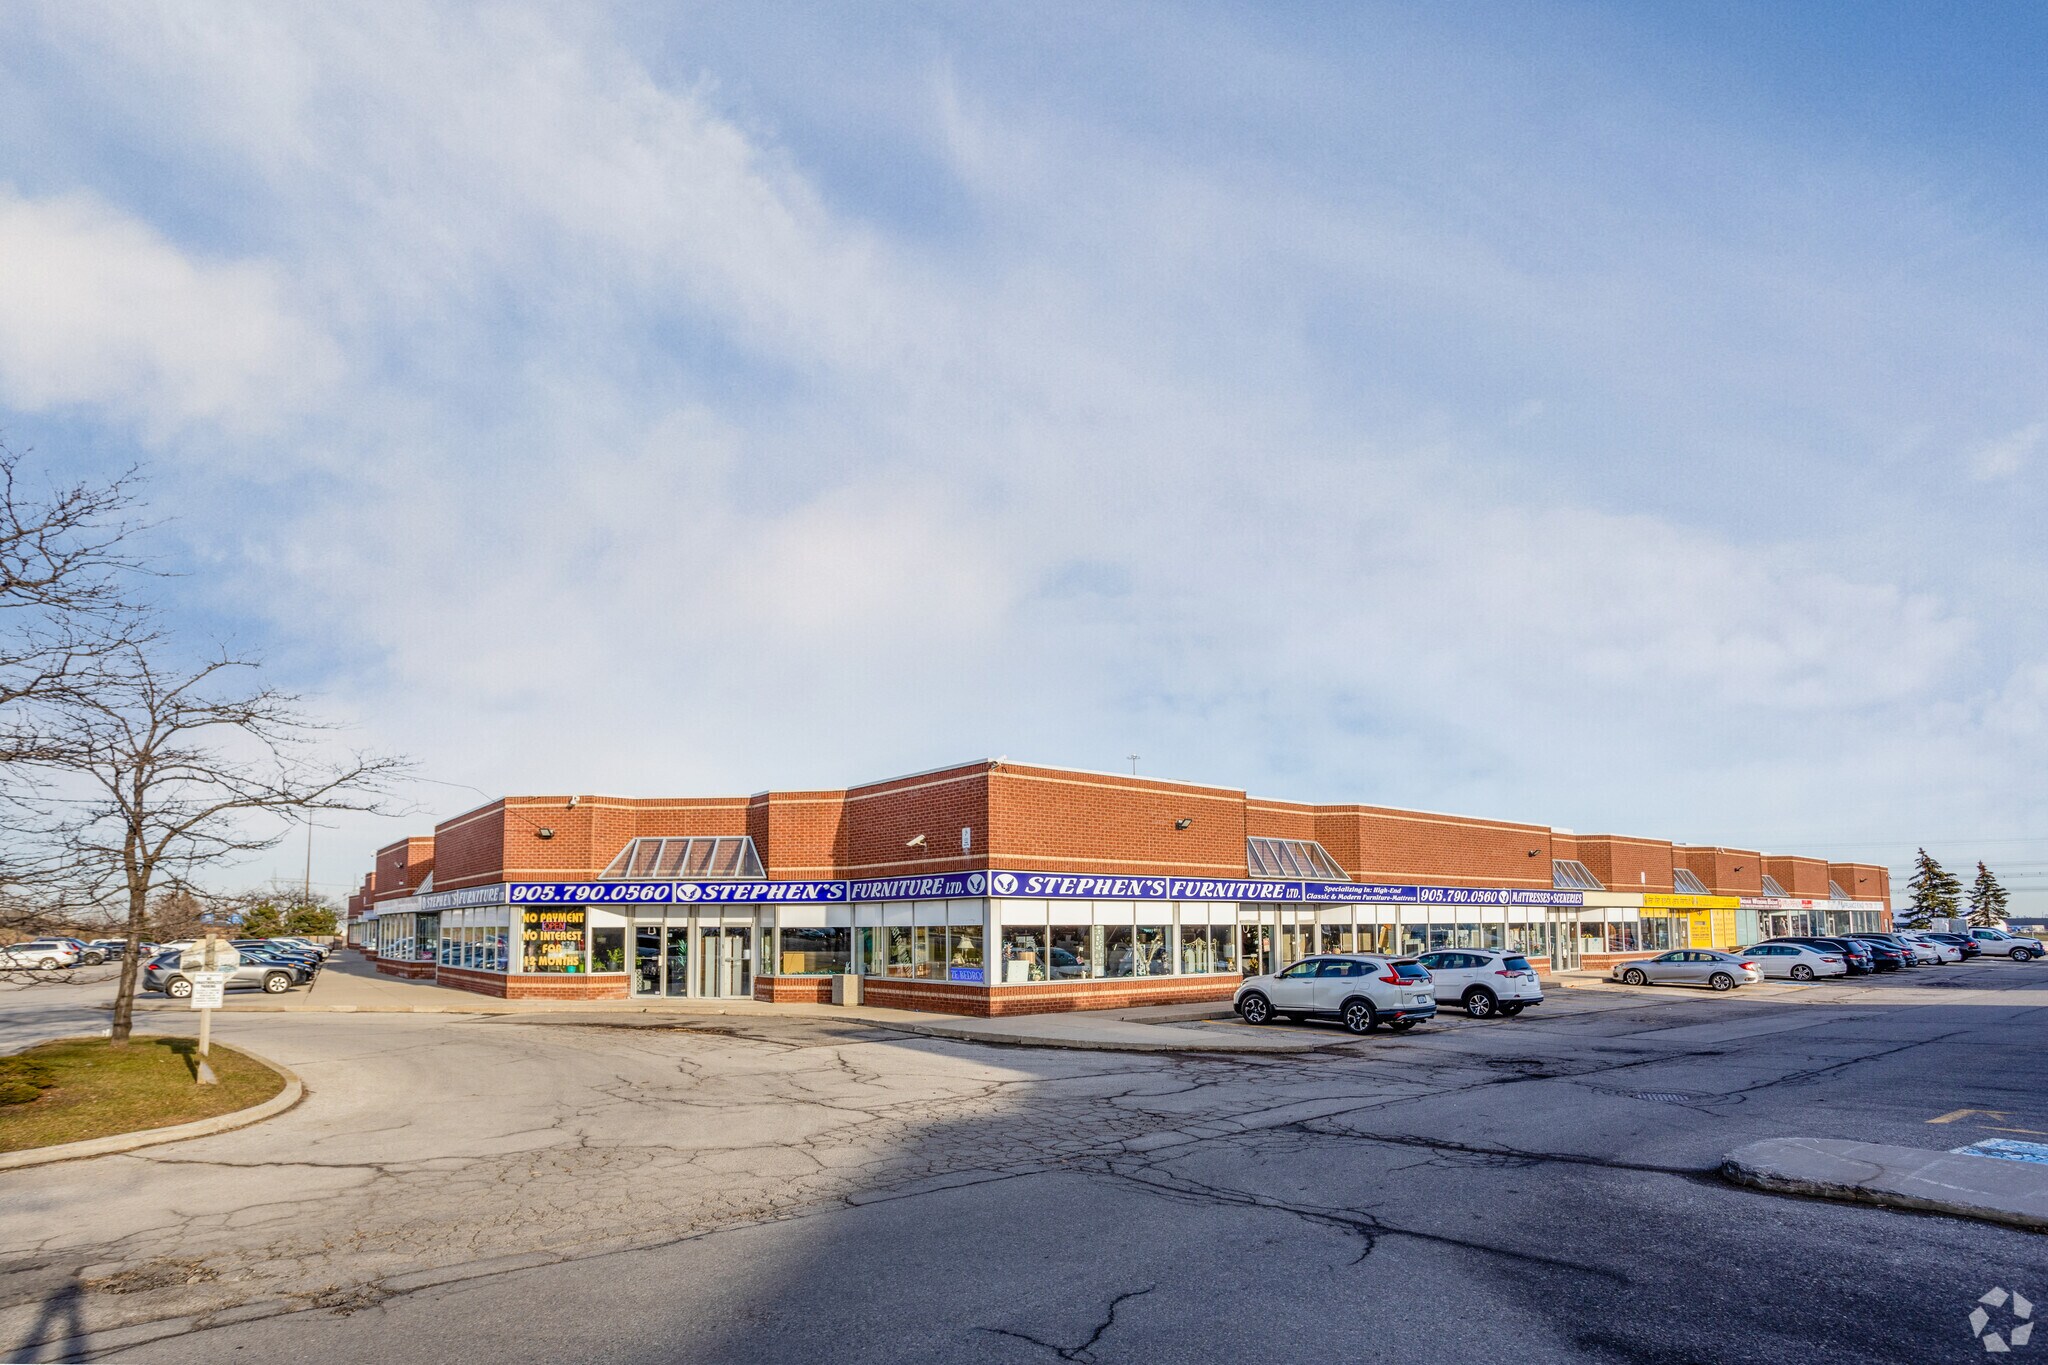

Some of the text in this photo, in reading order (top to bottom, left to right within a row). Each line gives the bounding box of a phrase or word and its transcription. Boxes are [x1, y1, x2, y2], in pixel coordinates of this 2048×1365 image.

[512, 885, 670, 901] 905.790.0560
[702, 883, 845, 900] STEPHEN'S
[851, 877, 964, 899] FURNITURE LTD.
[1024, 876, 1301, 899] STEPHEN'S FURNITURE LTD.
[1324, 885, 1363, 893] Specializing
[458, 887, 500, 905] FURNITURE
[1420, 888, 1498, 903] 905.790.0560
[522, 912, 584, 923] NO PAYMENT
[543, 922, 565, 930] OPEN
[522, 931, 582, 941] NO INTEREST
[542, 944, 562, 953] FOR
[524, 956, 579, 966] 12 MONTHS
